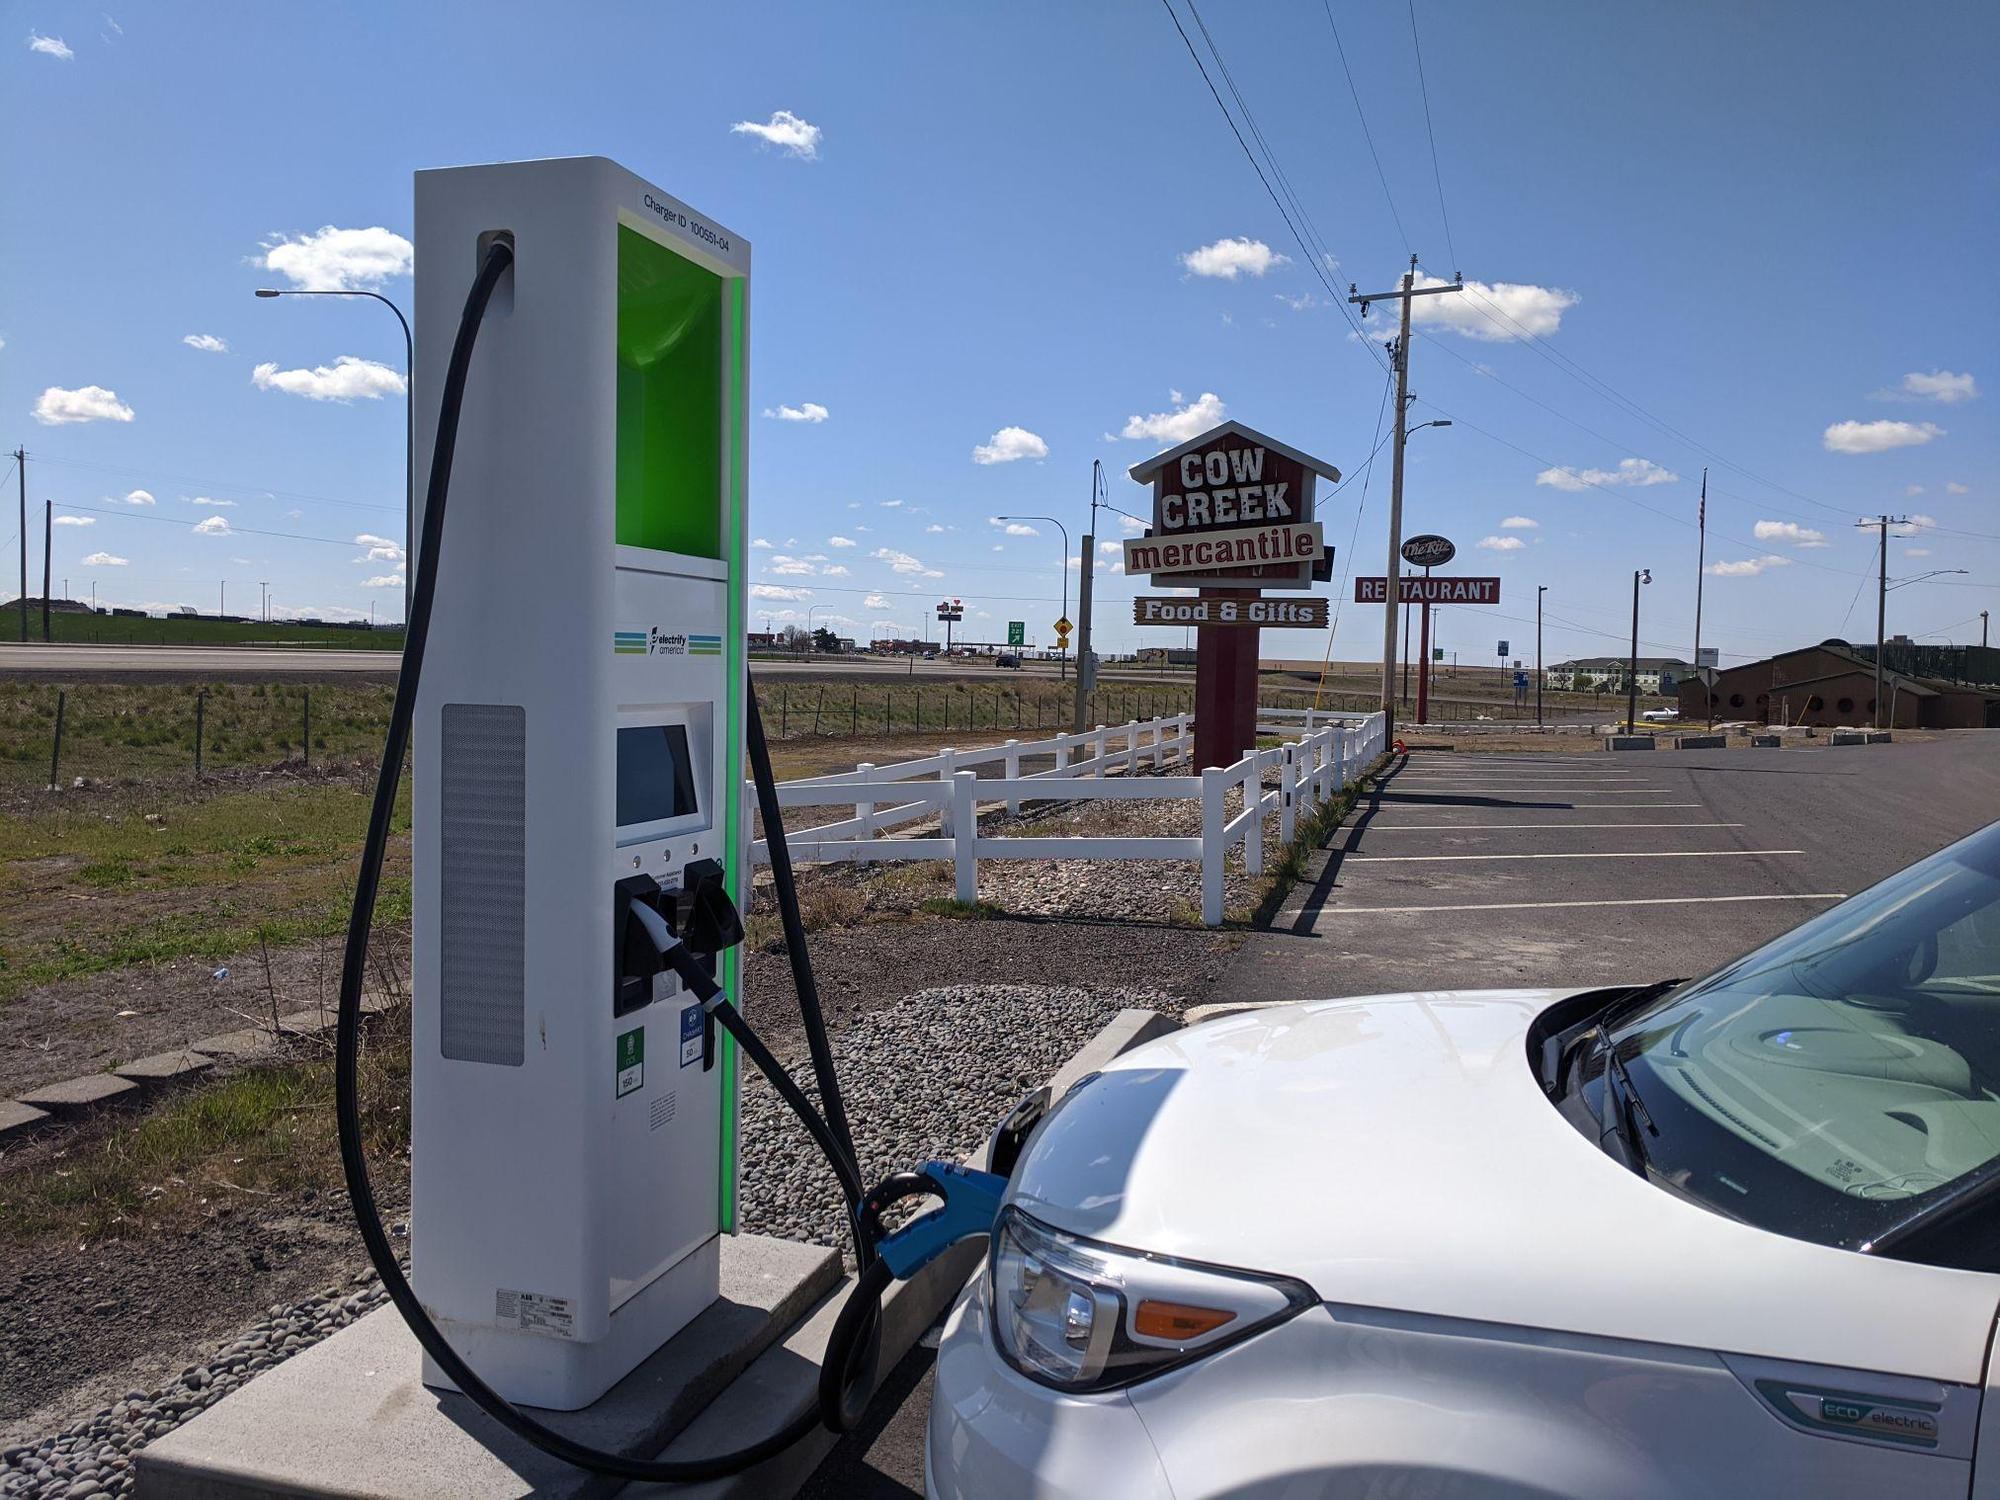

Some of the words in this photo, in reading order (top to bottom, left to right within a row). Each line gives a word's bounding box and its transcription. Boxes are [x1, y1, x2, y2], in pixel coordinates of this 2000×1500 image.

[644, 194, 677, 222] Charger
[678, 213, 687, 228] ID
[690, 221, 729, 252] 100551-04
[1180, 447, 1265, 489] COW
[1161, 482, 1292, 529] CREEK
[1131, 528, 1314, 570] mercantile
[1361, 580, 1493, 600] RETAURANT
[1144, 600, 1209, 621] Food
[1219, 602, 1237, 622] &
[1249, 602, 1314, 623] Gifts
[658, 634, 687, 647] electrify
[659, 645, 684, 655] america
[1823, 1403, 1859, 1419] ECO
[1872, 1411, 1932, 1431] electric
